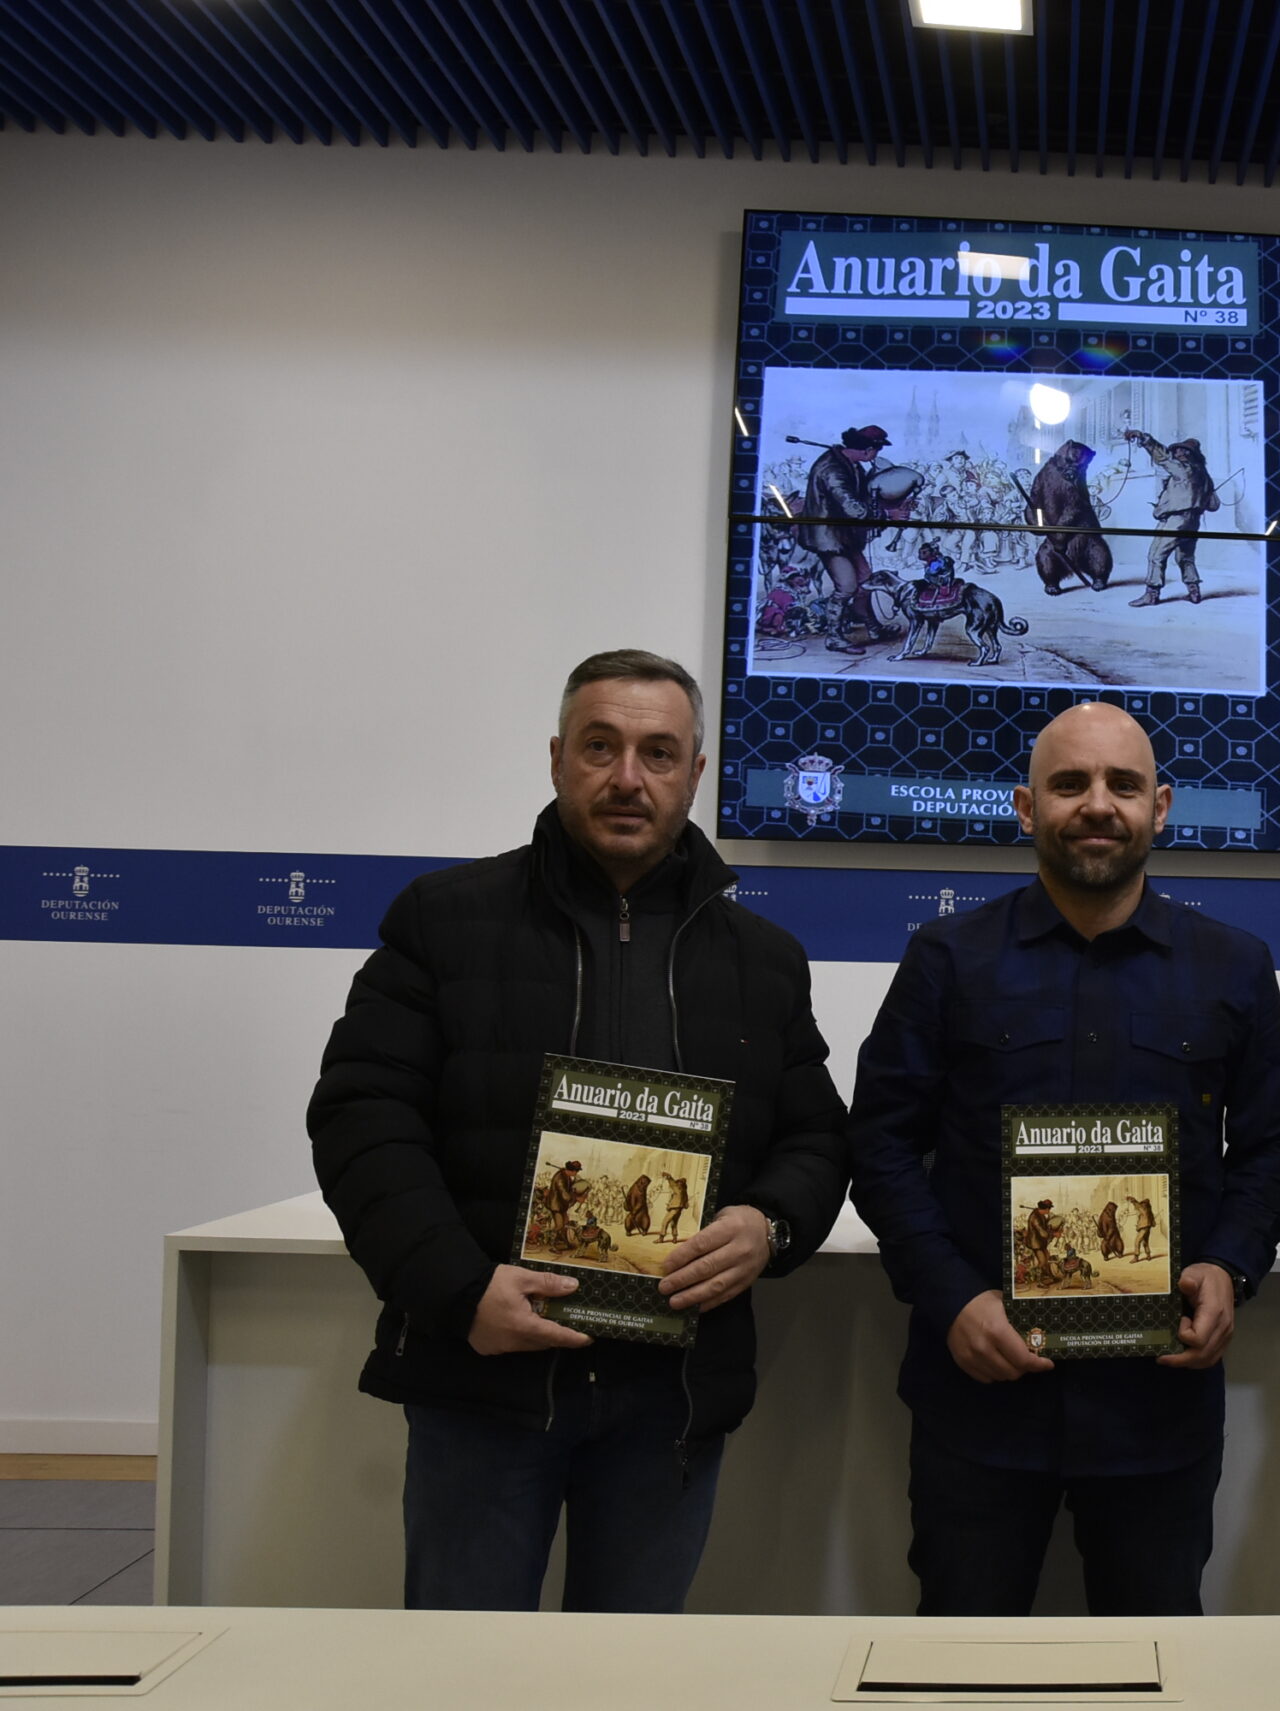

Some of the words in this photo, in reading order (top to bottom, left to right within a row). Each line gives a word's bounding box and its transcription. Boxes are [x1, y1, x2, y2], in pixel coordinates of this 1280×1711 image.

[786, 239, 1001, 297] Anuario
[1019, 242, 1083, 299] da
[1100, 246, 1247, 305] Gaita
[976, 301, 1051, 320] 2023
[1215, 310, 1239, 324] 38
[890, 784, 956, 800] ESCOLA
[962, 788, 1014, 801] PROVI
[41, 899, 119, 911] DEPUTACIÓN
[257, 904, 335, 917] DEPUTACIÓN
[51, 911, 109, 921] OURENSE
[267, 916, 324, 927] OURENSE
[554, 1073, 631, 1110] Anuario
[635, 1087, 658, 1114] da
[664, 1090, 714, 1122] Gaita
[619, 1110, 646, 1122] 2023
[700, 1123, 709, 1131] 38
[1016, 1120, 1086, 1145] Anuario
[1091, 1120, 1112, 1144] da
[1116, 1119, 1163, 1144] Gaita
[1078, 1145, 1103, 1154] 2023
[563, 1306, 586, 1315] ESCOLA
[586, 1310, 622, 1320] PROVINCIAL
